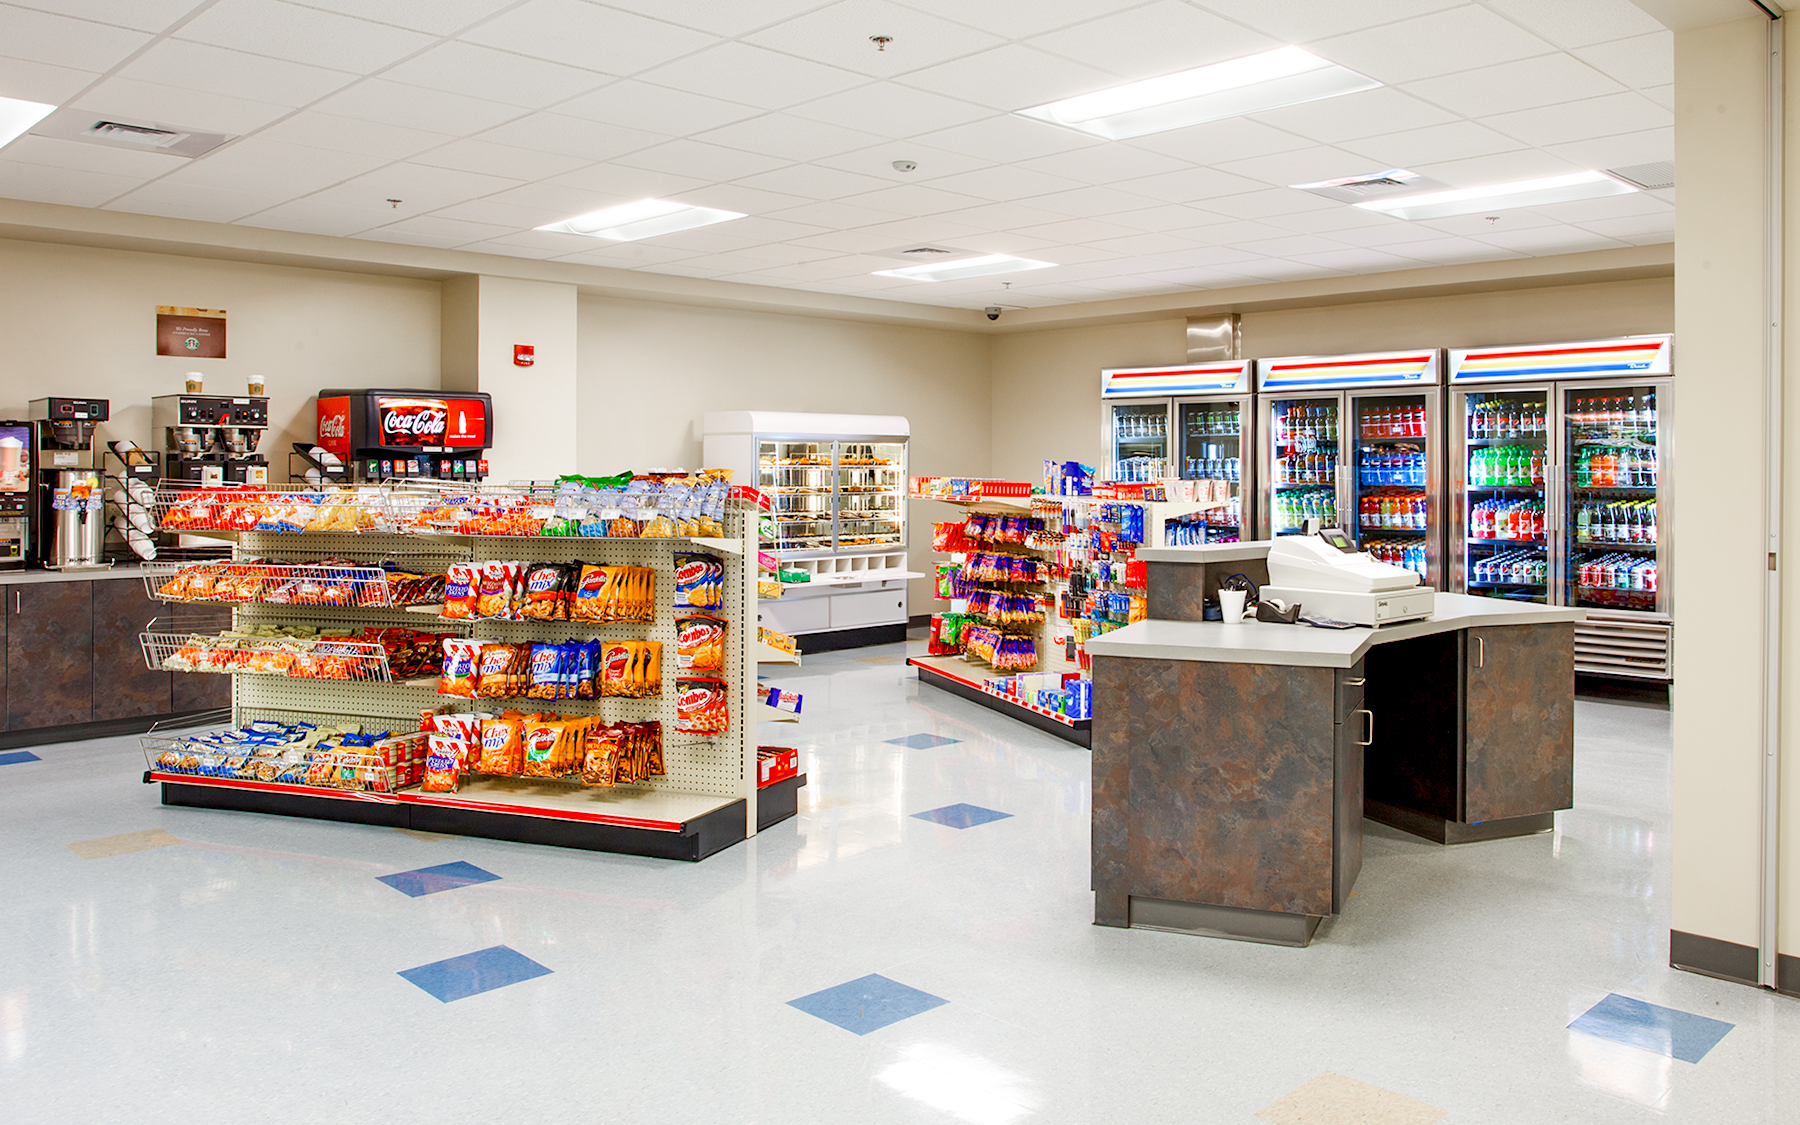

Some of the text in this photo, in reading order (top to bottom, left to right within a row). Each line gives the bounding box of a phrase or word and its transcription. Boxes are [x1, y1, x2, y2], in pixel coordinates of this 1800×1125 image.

[320, 414, 346, 438] Coca-Cola
[383, 409, 447, 435] Coca-Cola
[530, 569, 559, 582] Chex
[530, 577, 555, 591] mix
[678, 627, 711, 644] Combos
[482, 656, 506, 666] Chex
[532, 650, 558, 663] Chex
[482, 661, 504, 673] mix
[533, 660, 556, 672] mix
[677, 690, 709, 707] Combos
[483, 726, 511, 739] Chex
[484, 735, 508, 748] mix
